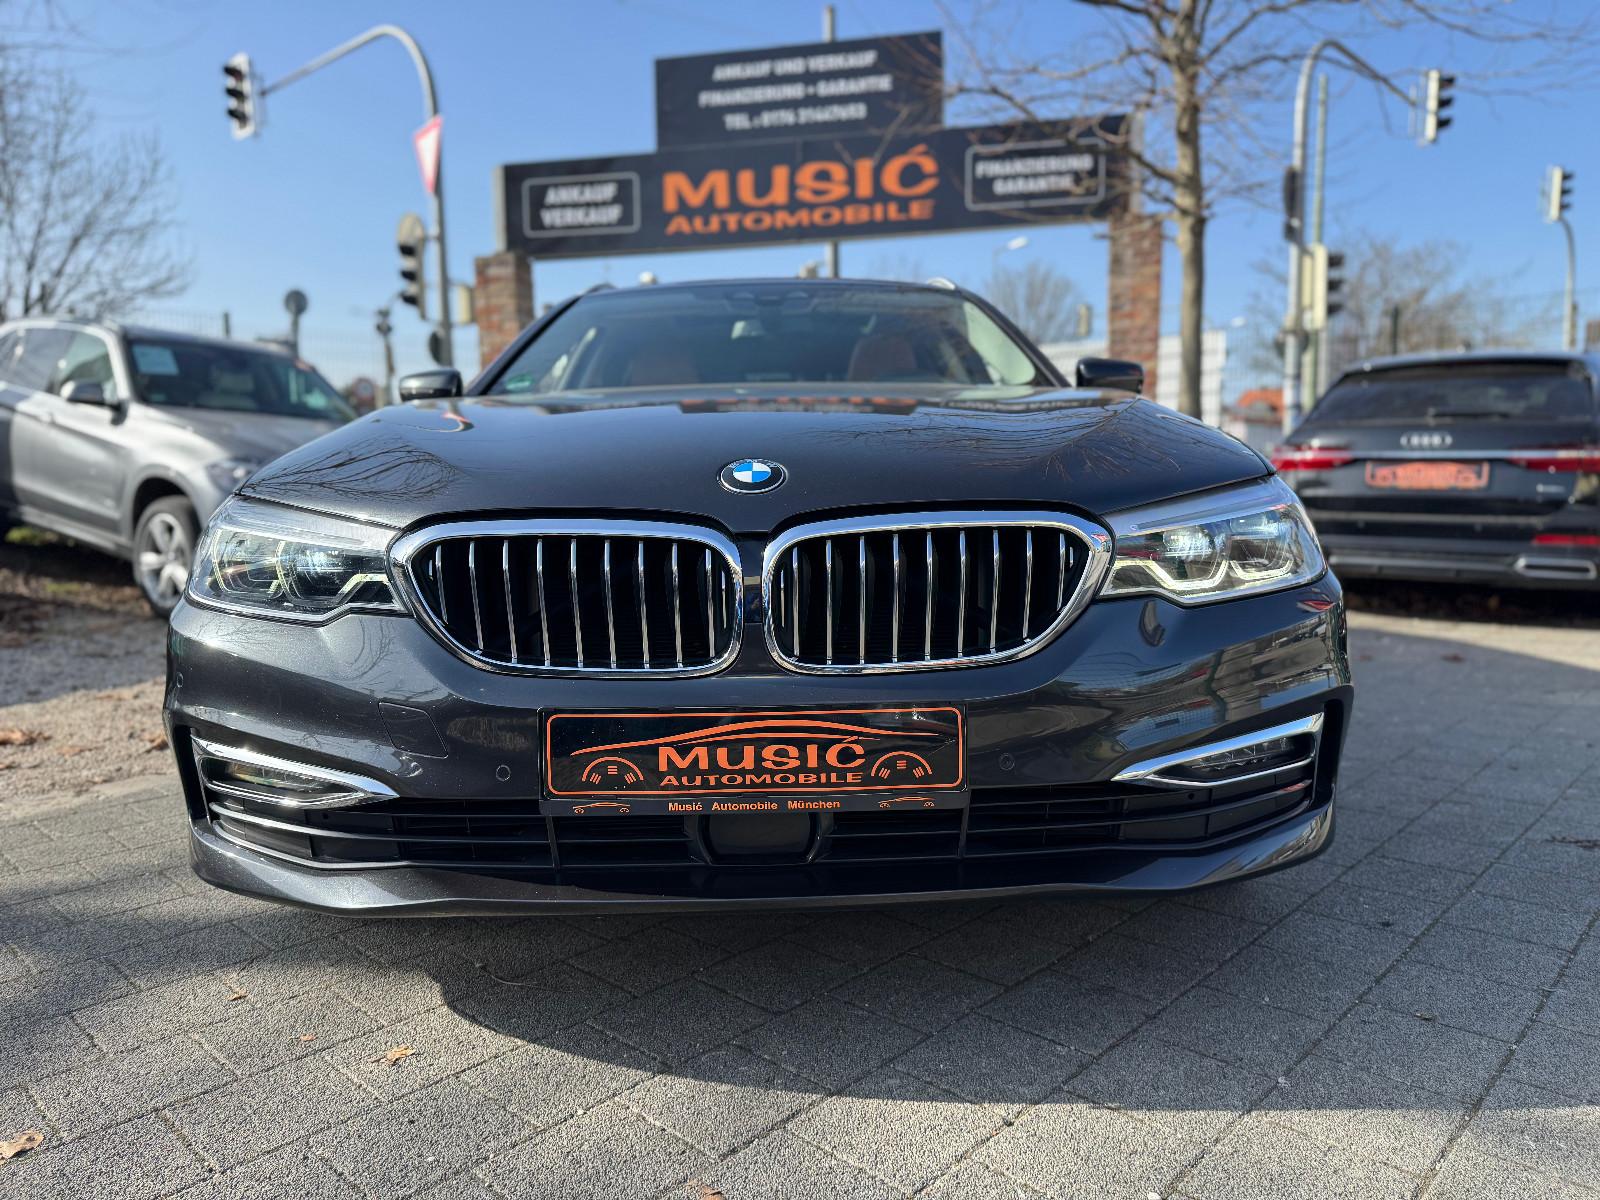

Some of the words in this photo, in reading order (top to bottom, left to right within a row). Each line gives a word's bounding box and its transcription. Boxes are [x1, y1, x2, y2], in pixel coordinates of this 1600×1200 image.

[712, 60, 772, 81] ANKAUF
[774, 57, 806, 76] UND
[807, 50, 878, 73] VERKAUF
[698, 82, 806, 108] FINANZIERUNG
[816, 74, 893, 98] GARANTIE
[662, 144, 940, 213] MUSIĆ
[975, 154, 1094, 179] FINANZIERUNG
[544, 182, 619, 206] ANKAUF
[993, 174, 1076, 196] GARANTIE
[540, 203, 623, 229] VERKAUF
[664, 199, 936, 236] AUTOMOBILE
[658, 735, 866, 772] MUSIĆ
[659, 772, 864, 786] AUTOMOBILE
[668, 801, 703, 812] Musić
[712, 800, 778, 811] Automobile
[787, 799, 841, 810] München
